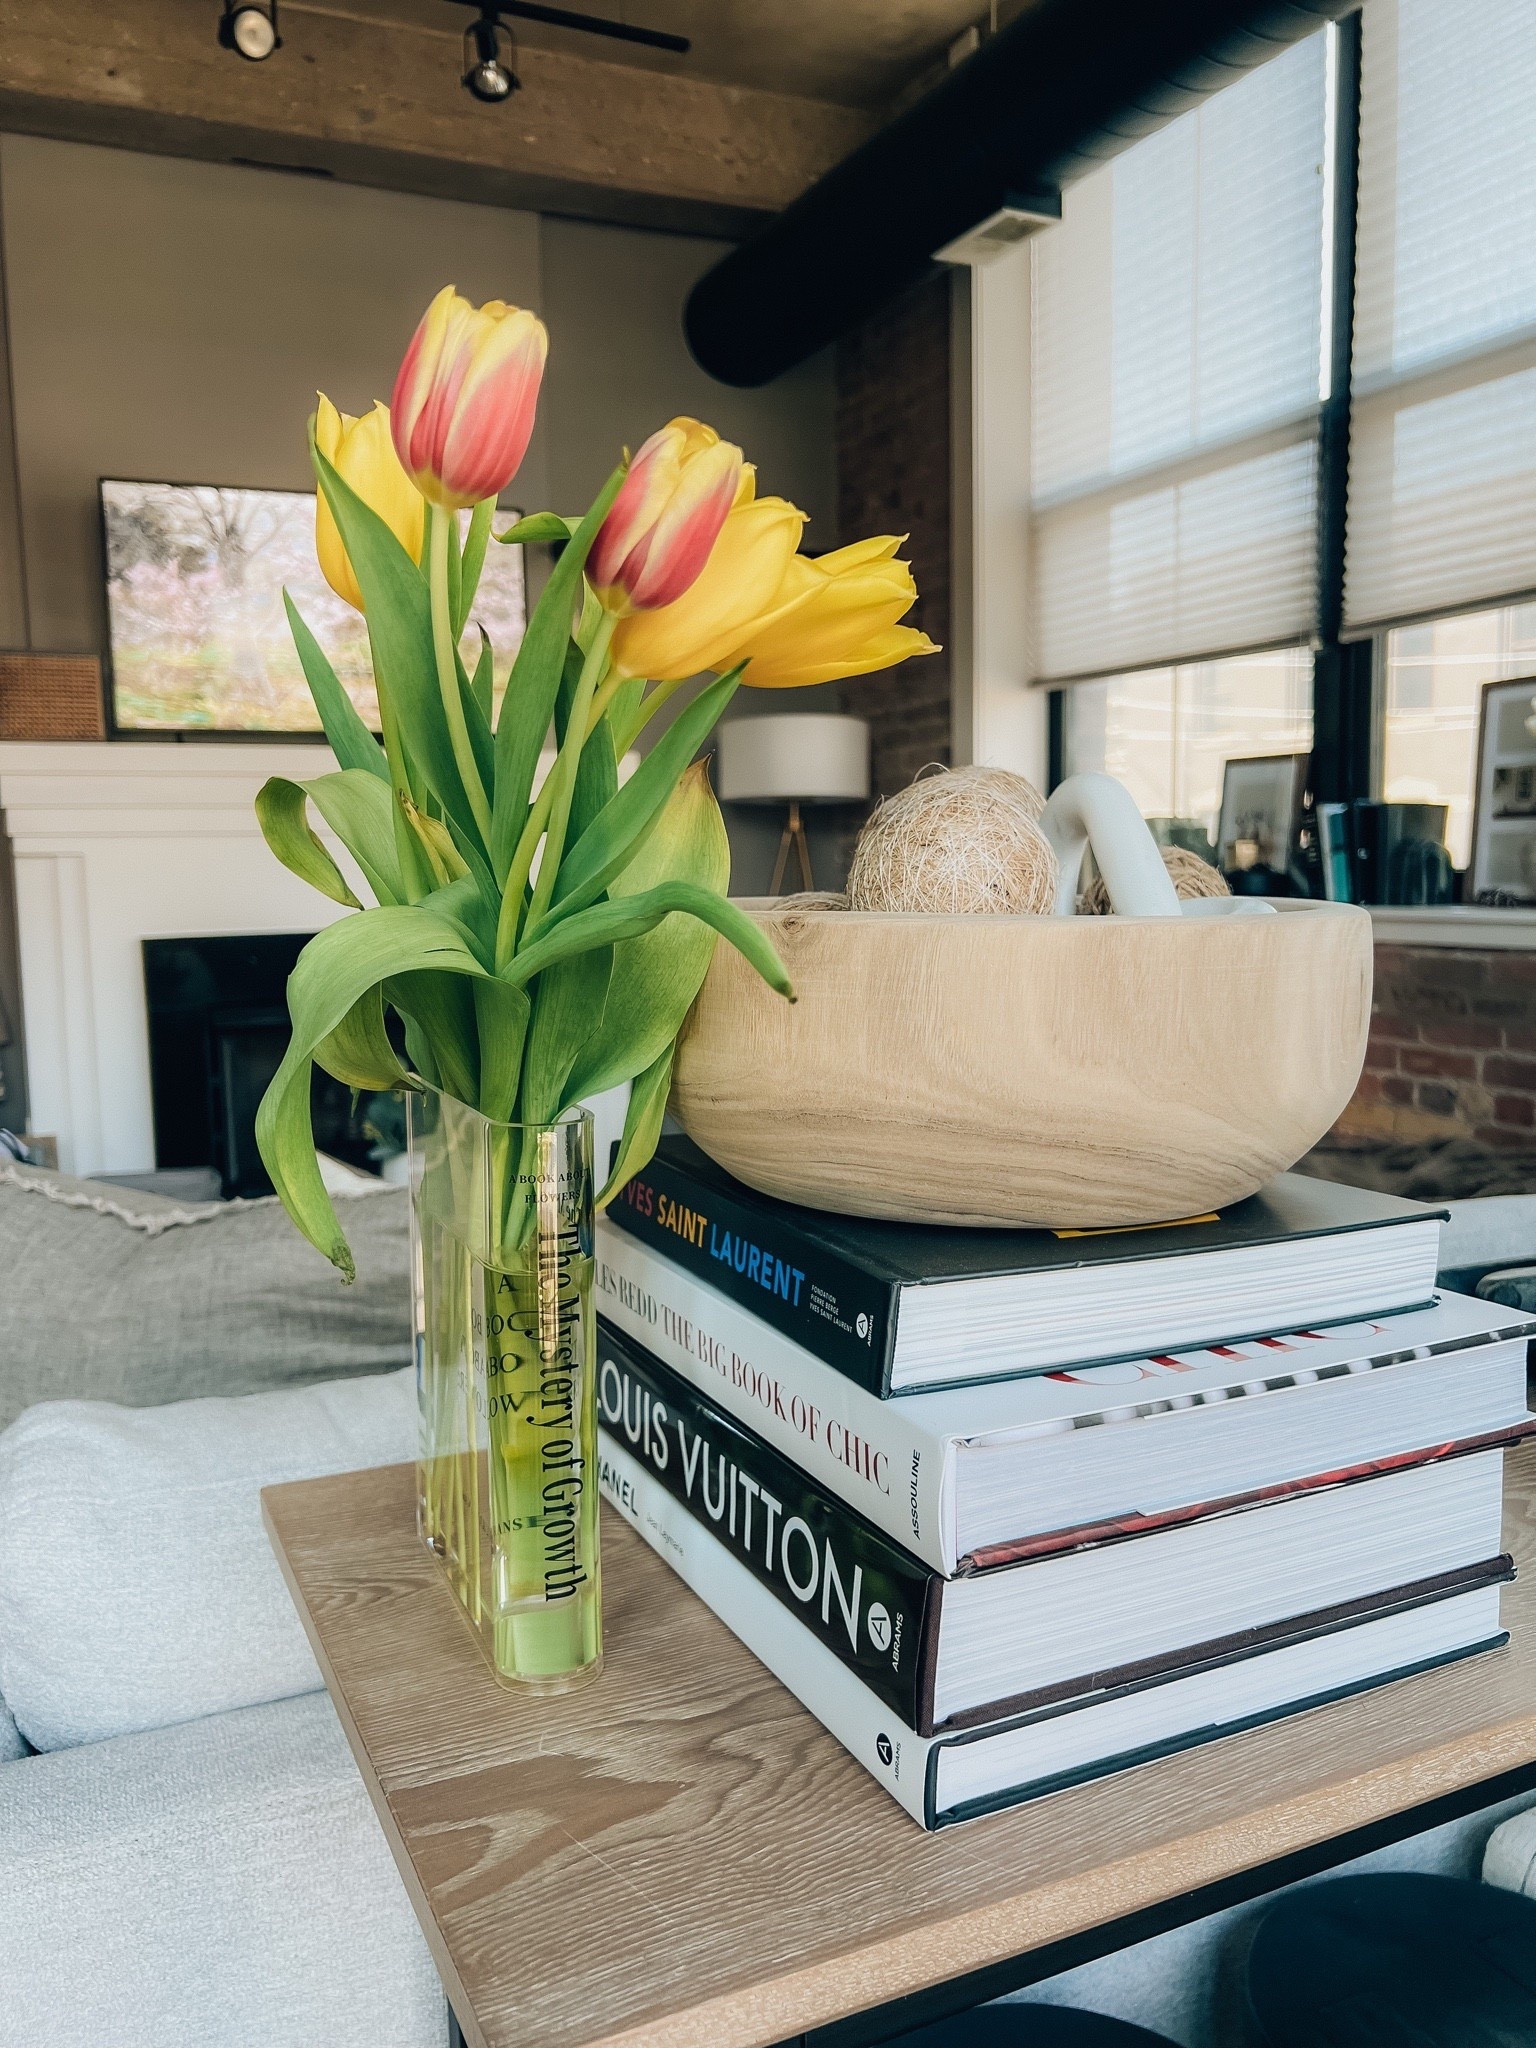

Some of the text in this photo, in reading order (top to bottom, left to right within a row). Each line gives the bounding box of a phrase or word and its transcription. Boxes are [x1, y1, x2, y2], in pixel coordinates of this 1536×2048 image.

[509, 1174, 517, 1184] A
[519, 1174, 555, 1184] BOOK
[620, 1180, 806, 1307] VES SAINT LAURENT
[809, 1302, 853, 1333] YVES SAINT LAURENT
[810, 1293, 825, 1308] PIERRE
[811, 1284, 837, 1304] FONDATION
[867, 1314, 875, 1348] ABRAMS
[619, 1275, 658, 1326] REDD
[661, 1303, 695, 1354] THE
[698, 1329, 727, 1377] BIG
[732, 1352, 789, 1423] BOOK
[791, 1394, 821, 1443] OF
[826, 1419, 890, 1497] CHIC
[524, 1223, 588, 1602] The Mystery of Growth
[597, 1359, 863, 1655] OUIS VUITTON
[911, 1448, 921, 1541] ASSOULINE
[890, 1612, 904, 1673] ABRAMS
[893, 1742, 902, 1782] ABRAMS
